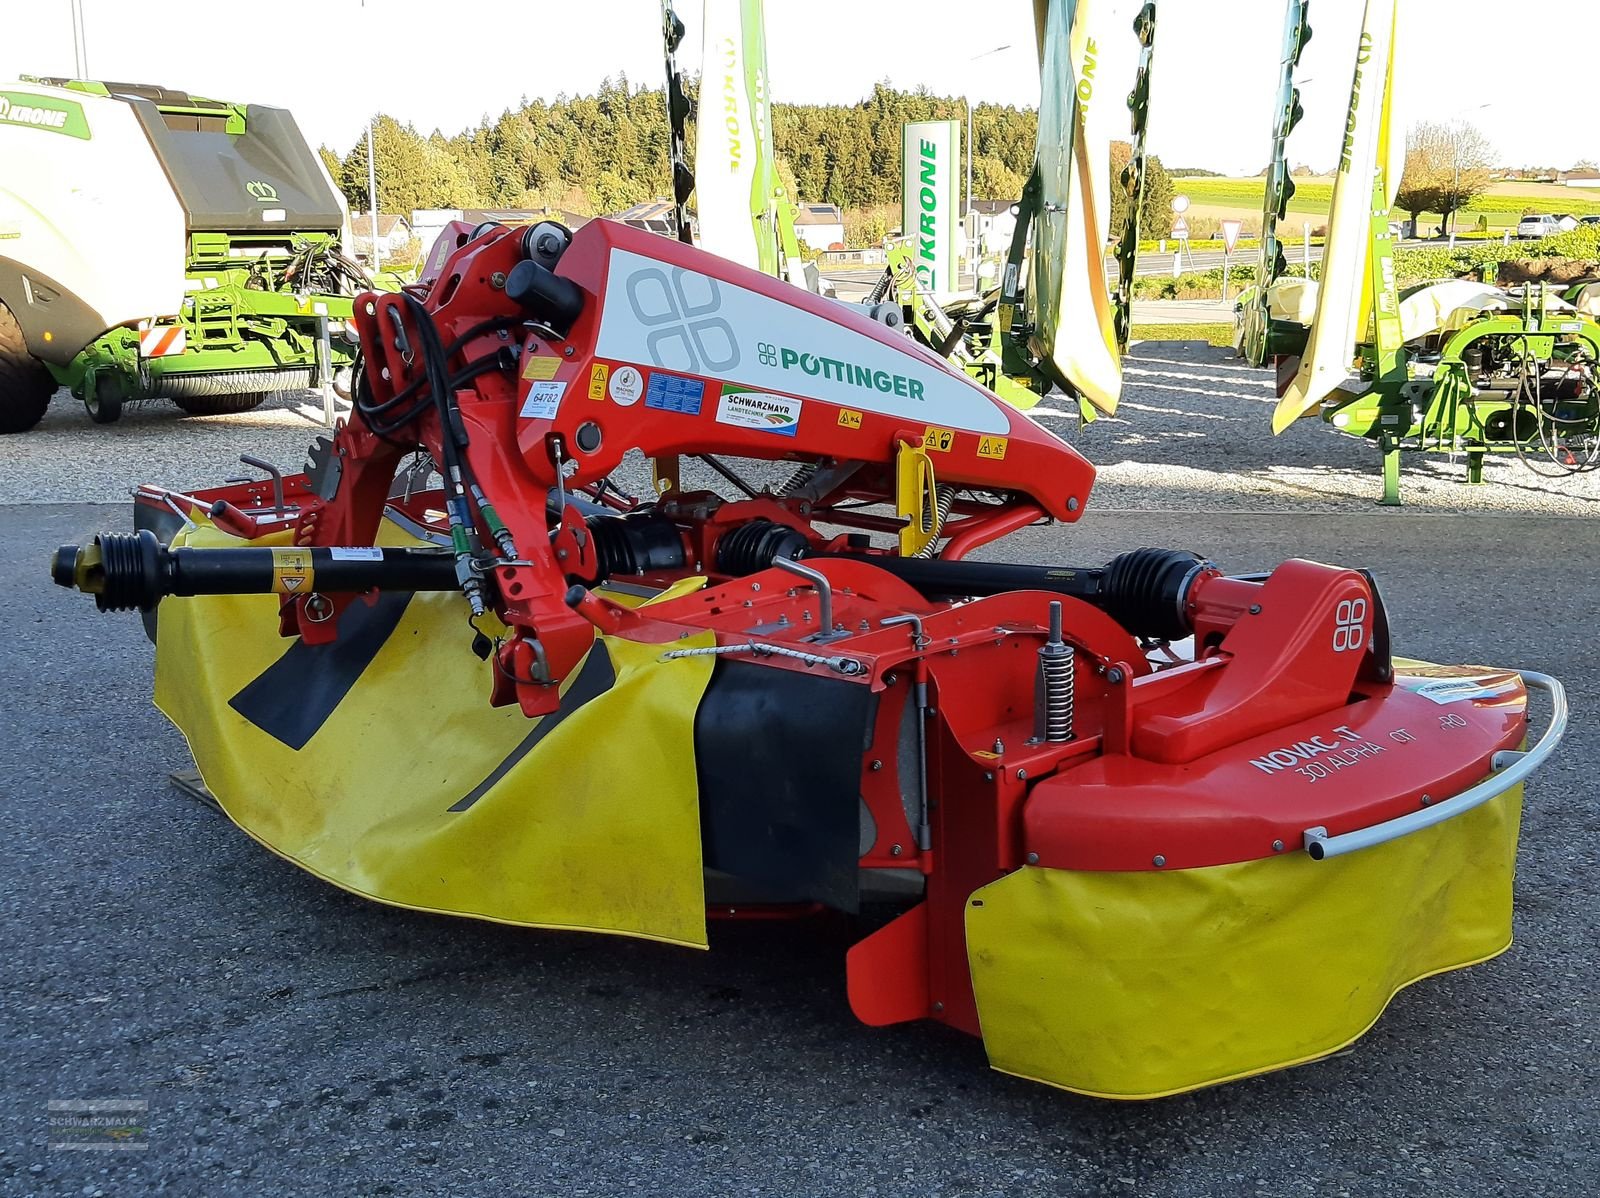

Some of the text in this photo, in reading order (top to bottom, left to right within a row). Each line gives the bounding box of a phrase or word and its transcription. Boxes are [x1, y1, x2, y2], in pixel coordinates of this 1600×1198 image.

[1078, 37, 1098, 124] ONE
[7, 105, 68, 127] KRONE
[724, 75, 741, 173] KRONE
[919, 138, 937, 261] KRONE
[780, 347, 925, 401] PÖTTINGER
[533, 393, 559, 403] 64782
[727, 405, 764, 418] LANDTECHNIK
[728, 395, 790, 415] SCHWARZMAYR
[1295, 761, 1333, 783] 301
[1327, 741, 1387, 770] ALPHA
